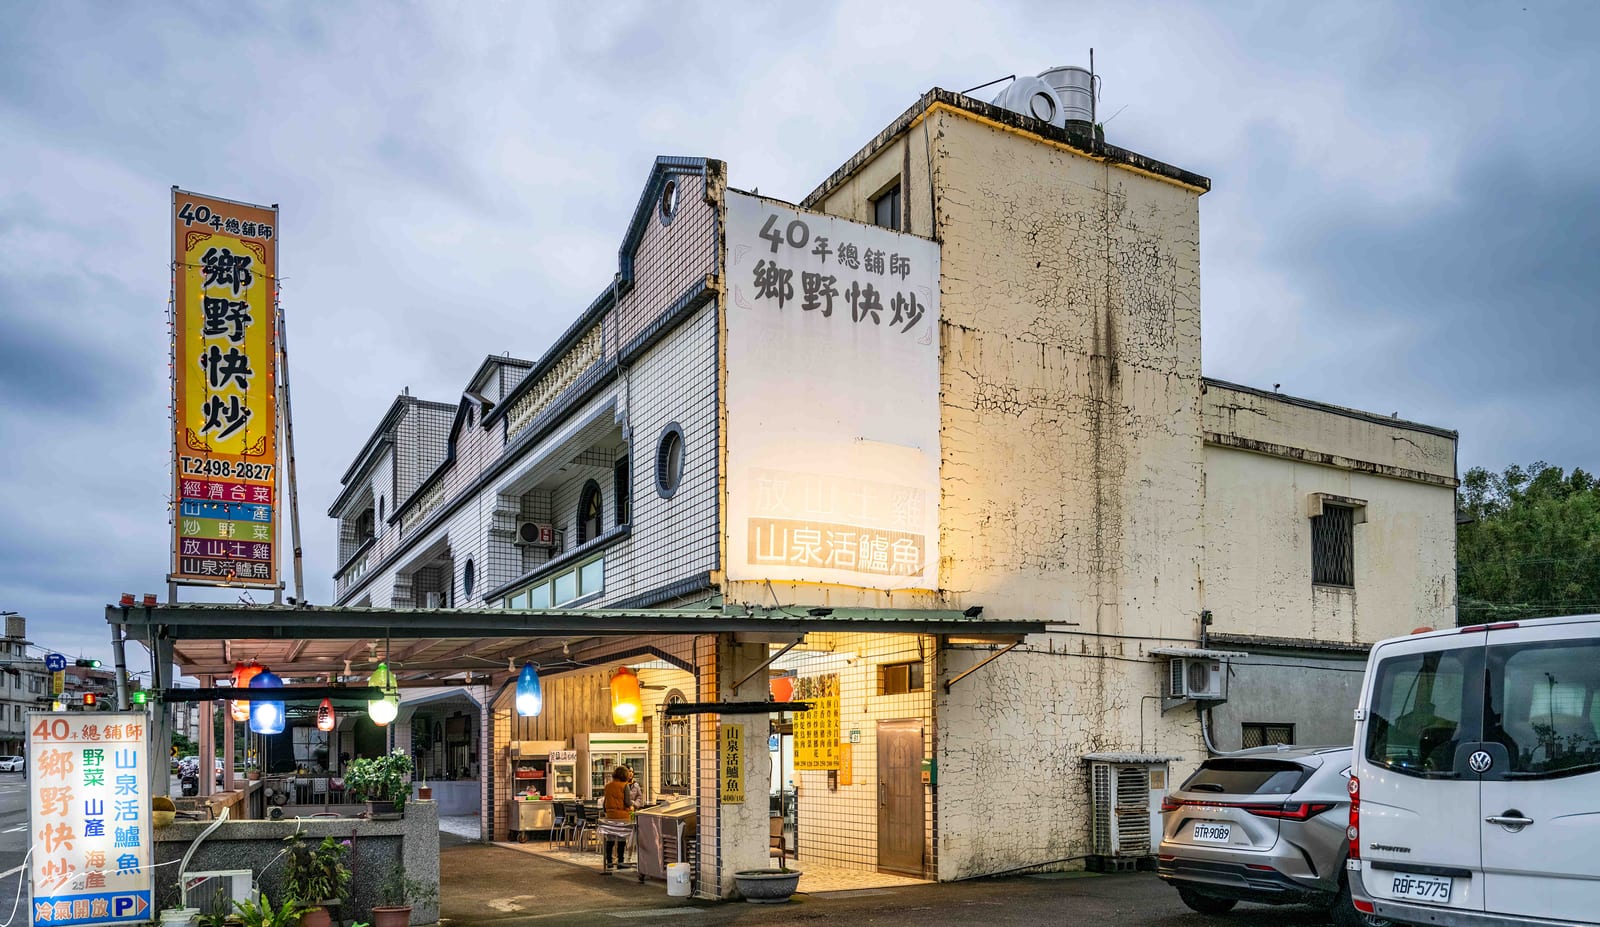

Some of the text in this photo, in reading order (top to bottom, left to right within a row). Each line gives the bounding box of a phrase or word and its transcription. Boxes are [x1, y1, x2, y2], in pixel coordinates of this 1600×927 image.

[178, 203, 273, 239] 40年總舖師
[758, 213, 911, 280] 40年總舖師
[753, 259, 925, 333] 鄉野快炒
[201, 248, 252, 439] 鄉野快炒
[180, 457, 272, 480] T.2498-2827
[184, 481, 269, 502] 經濟合菜
[184, 540, 269, 560] 放山土雞
[756, 523, 920, 574] 山泉活鱸魚
[726, 727, 739, 792] 山泉活鱸魚
[37, 749, 76, 891] 鄉野快炒
[83, 749, 106, 889] 野菜 山產 海產
[114, 748, 141, 876] 山泉活鱸魚
[1194, 826, 1230, 840] BTR-9089
[35, 898, 109, 922] 冷氣開放
[1392, 878, 1449, 898] RBF-5775
